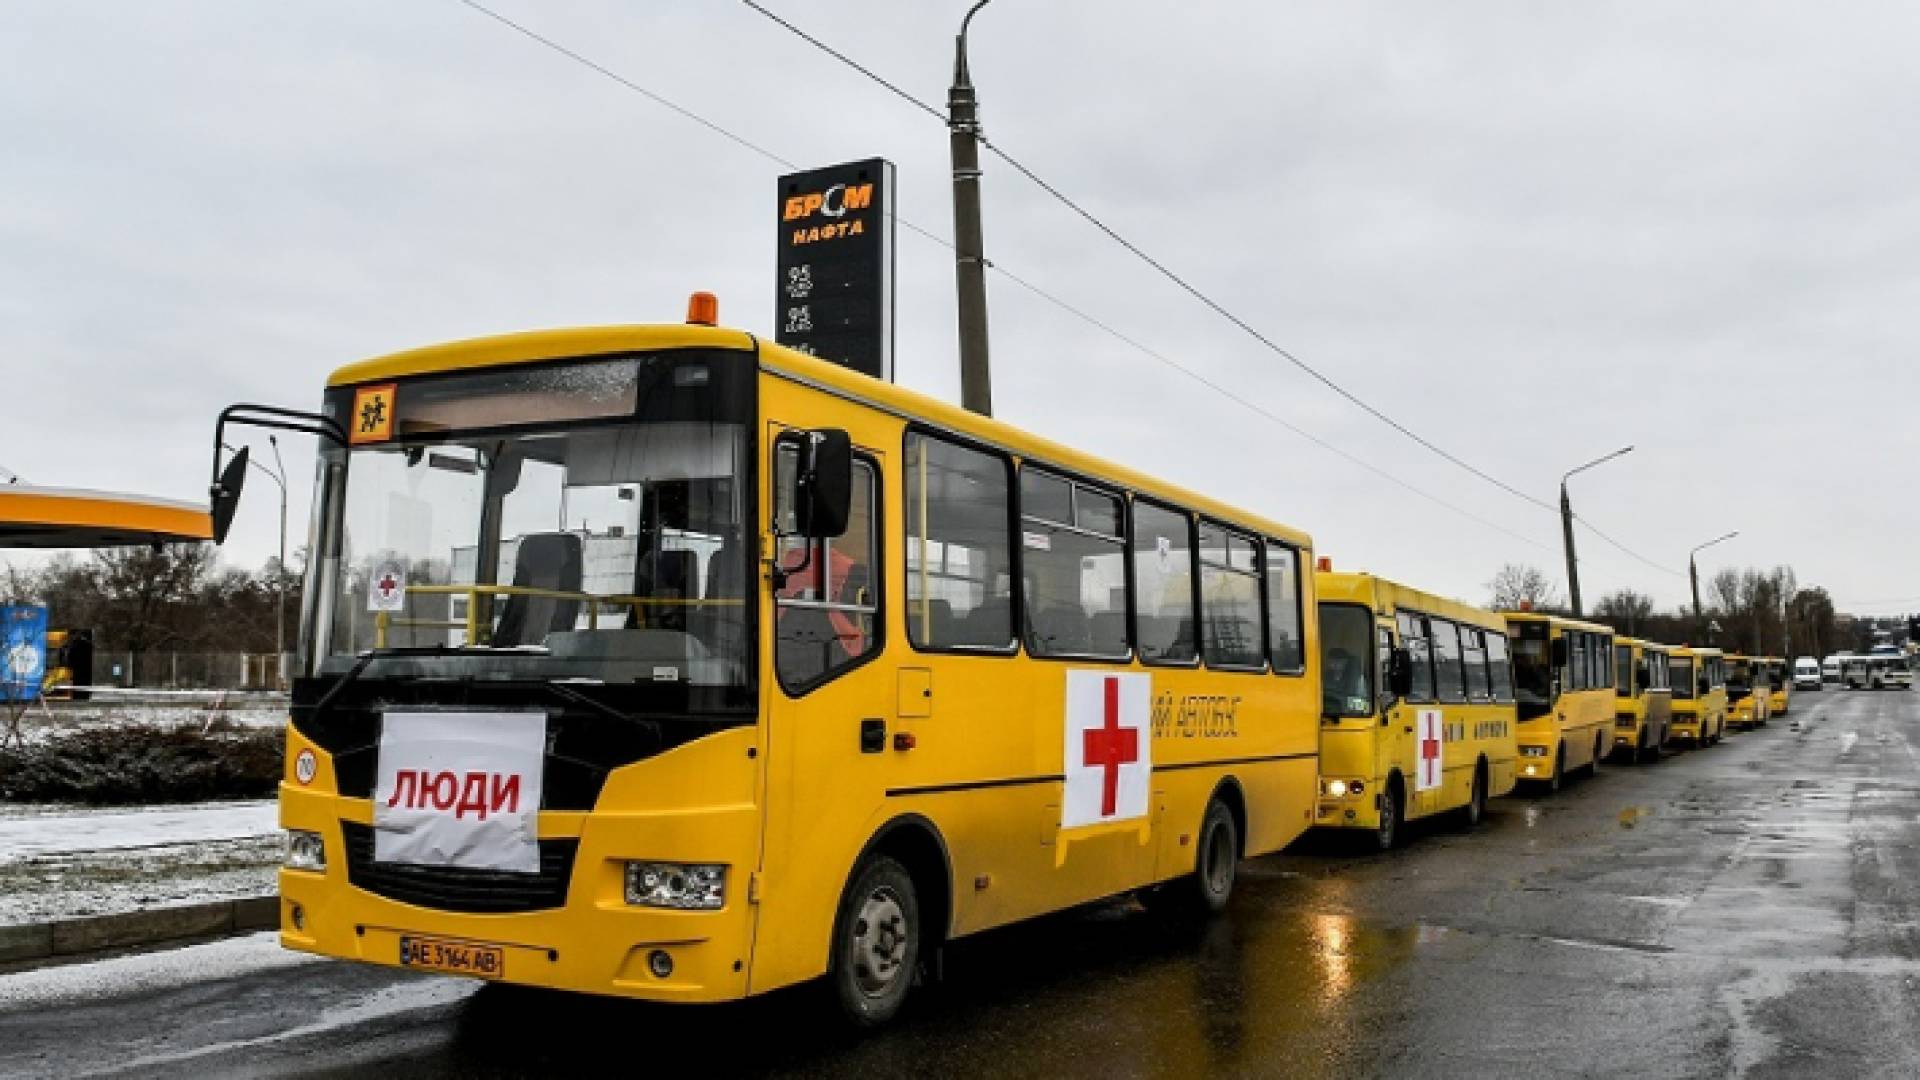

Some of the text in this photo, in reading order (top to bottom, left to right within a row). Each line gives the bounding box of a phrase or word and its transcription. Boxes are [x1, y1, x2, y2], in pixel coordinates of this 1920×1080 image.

[783, 184, 873, 220] БРСМ
[793, 220, 864, 246] НАФТА
[388, 769, 521, 821] ЛЮДИ
